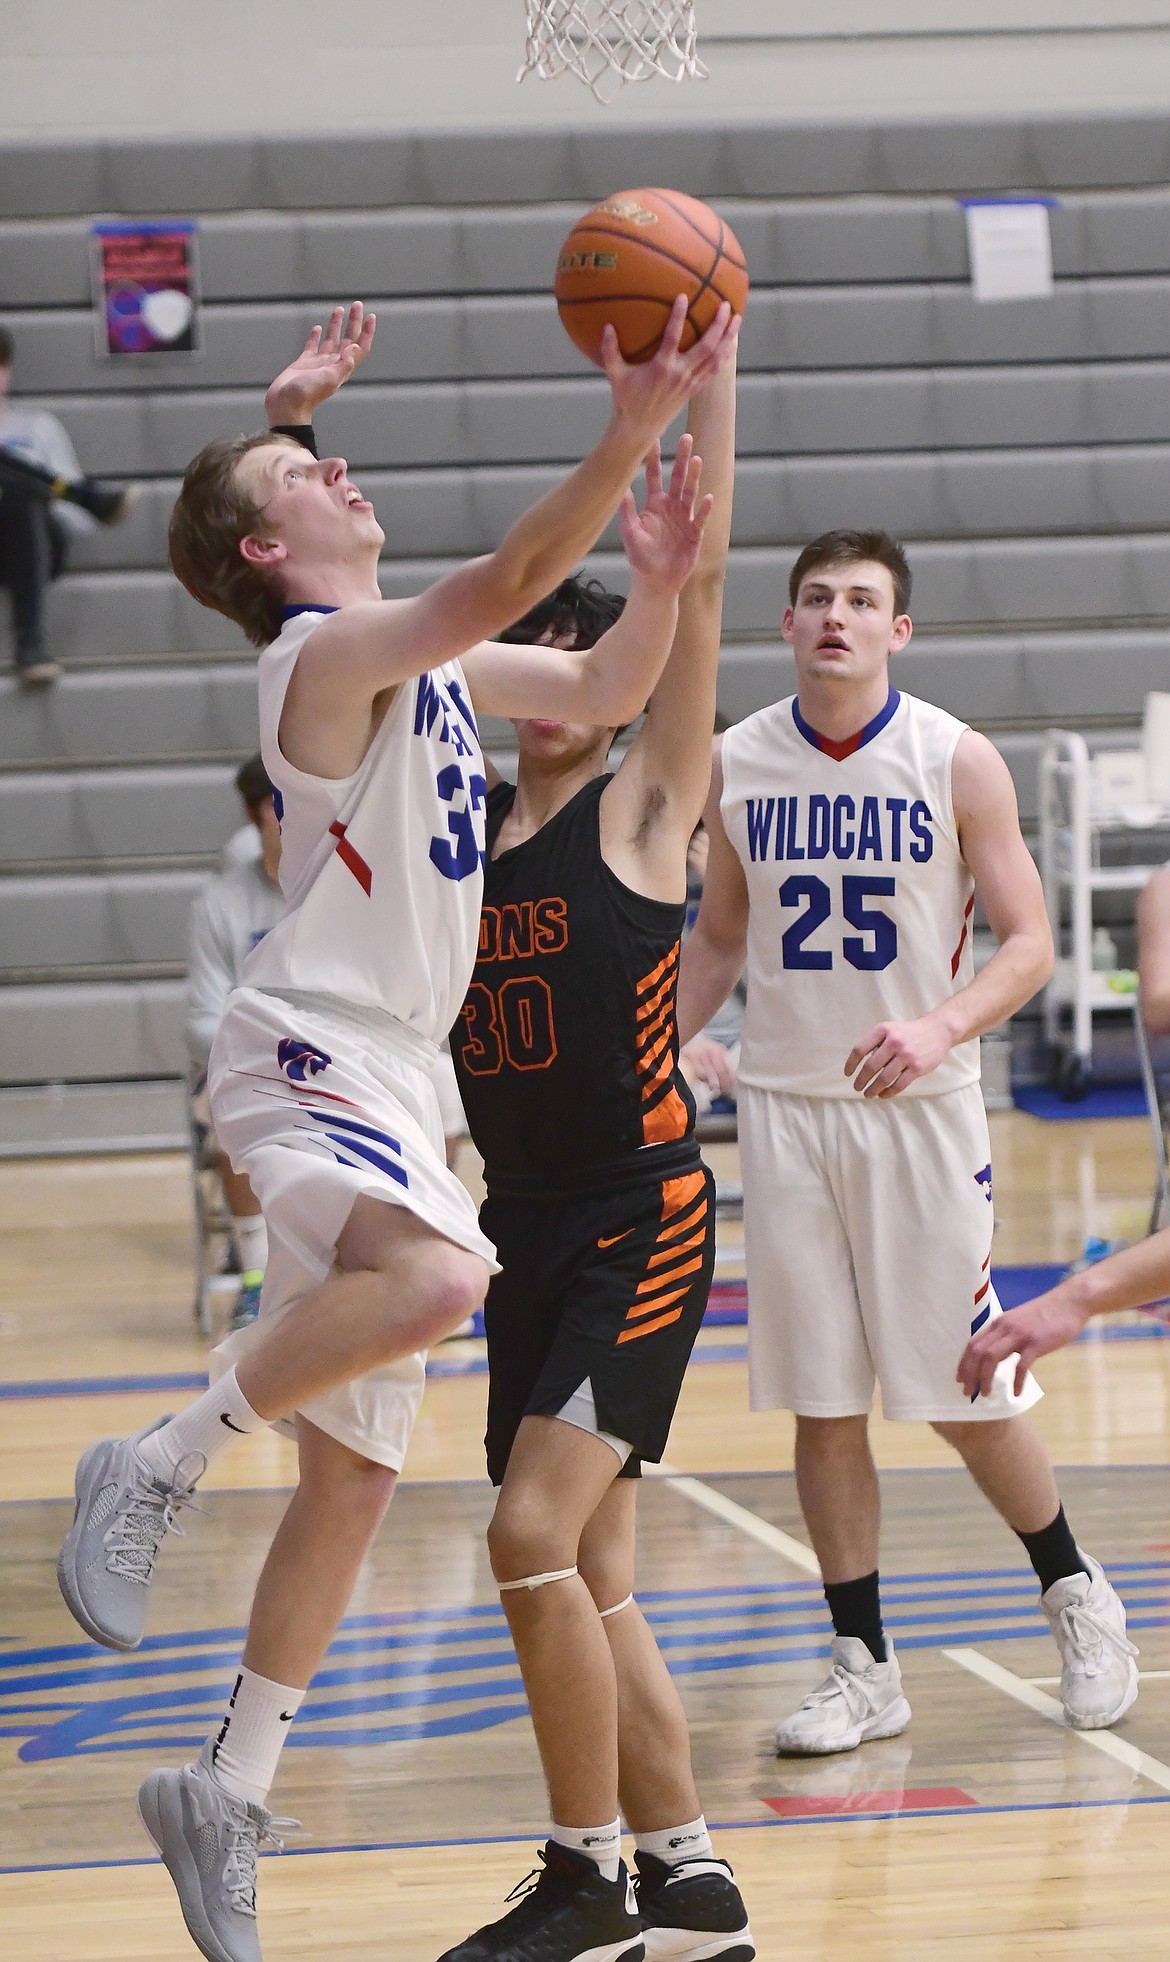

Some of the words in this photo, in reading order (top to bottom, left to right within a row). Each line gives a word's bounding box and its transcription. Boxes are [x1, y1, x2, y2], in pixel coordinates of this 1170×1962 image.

[746, 794, 934, 863] WILDCATS
[779, 875, 898, 971] 25
[460, 975, 558, 1076] 30
